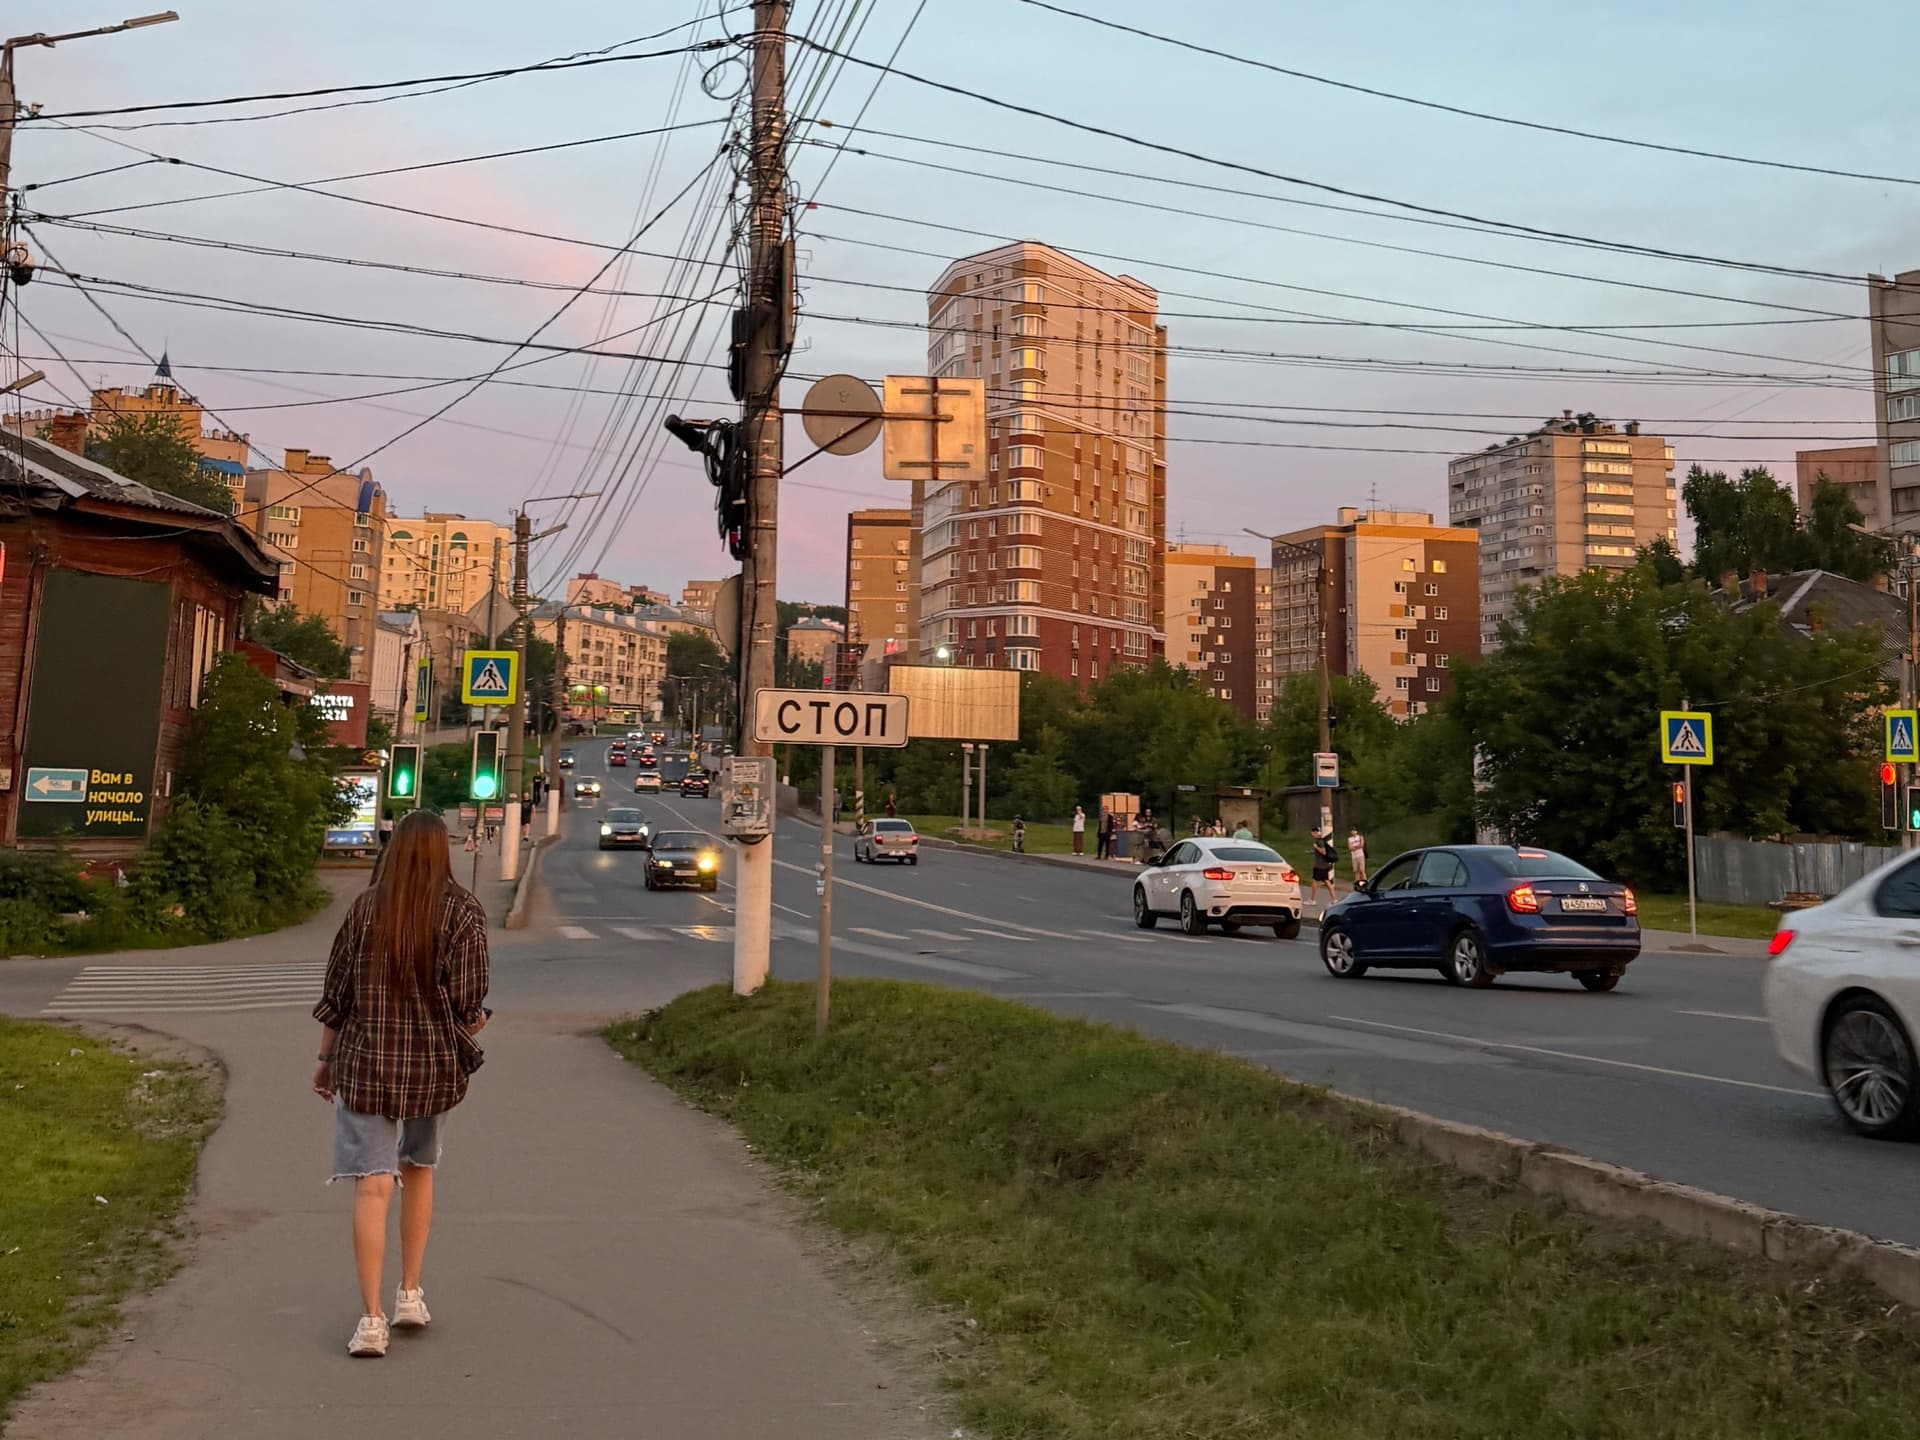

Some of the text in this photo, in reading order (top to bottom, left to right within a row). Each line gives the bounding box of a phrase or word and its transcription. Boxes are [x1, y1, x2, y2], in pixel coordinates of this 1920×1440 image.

[778, 700, 887, 736] СТОП
[91, 769, 133, 784] Вам в
[88, 791, 144, 803] начало
[85, 810, 144, 825] улицы...
